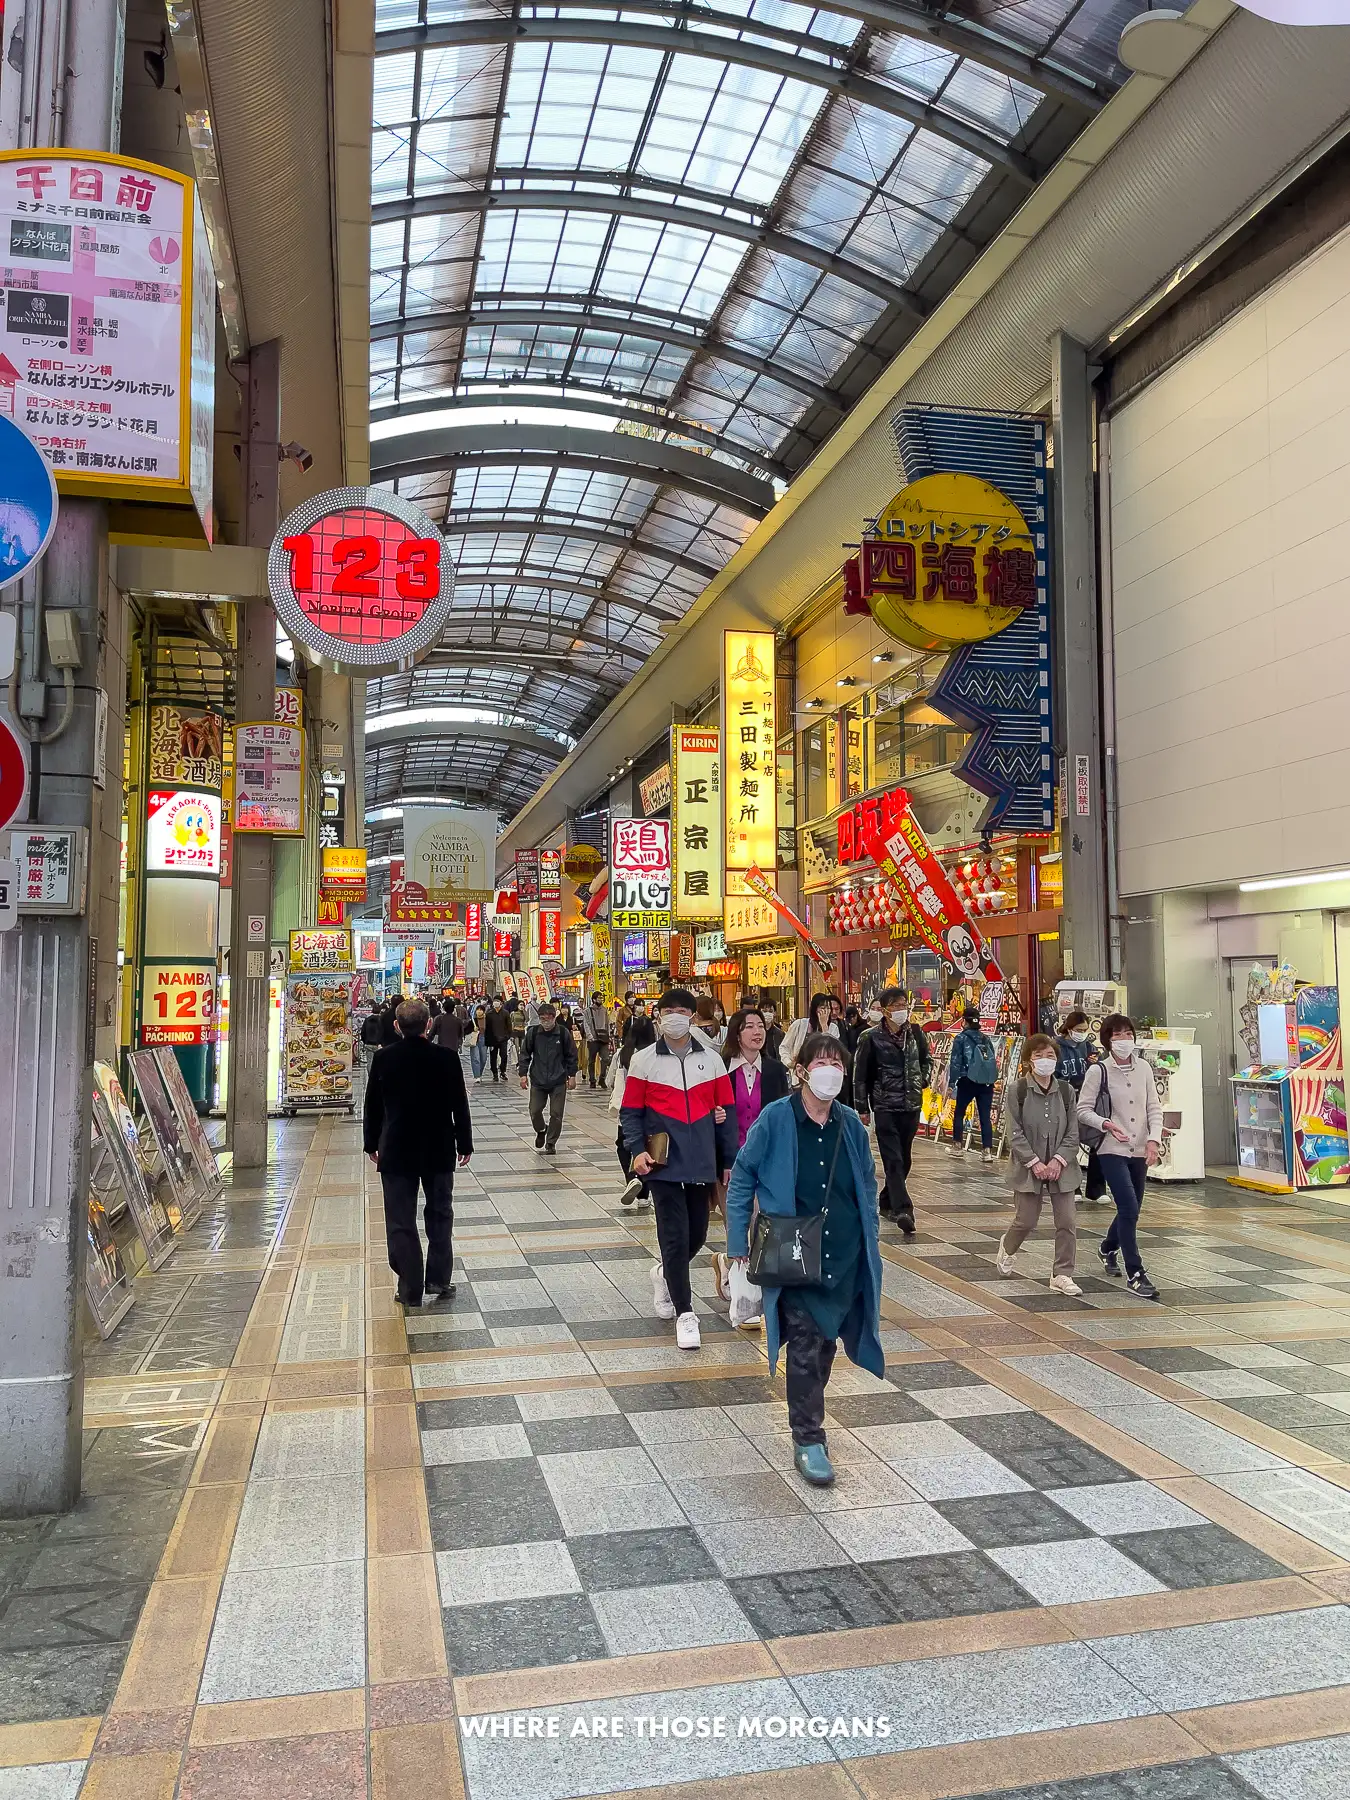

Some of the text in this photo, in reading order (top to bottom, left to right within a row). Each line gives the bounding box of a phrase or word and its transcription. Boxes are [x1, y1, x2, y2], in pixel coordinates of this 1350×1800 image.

[16, 166, 157, 212] 千日前
[16, 200, 152, 225] ミナミ千日前商店会
[26, 230, 56, 240] なんば
[12, 238, 69, 253] グランド花月
[159, 266, 169, 274] 北
[135, 281, 160, 293] 地下鉄
[22, 338, 58, 348] ローソン
[27, 358, 112, 376] 左側ローソン横
[27, 371, 175, 397] なんばオリエンタルホテル
[26, 409, 158, 434] なんばグランド花月
[33, 435, 87, 449] つ角右折
[862, 518, 1036, 544] スロットシアター
[283, 533, 441, 599] 123
[246, 726, 292, 739] 千日前
[762, 691, 774, 777] つけ麺専門店
[153, 708, 180, 781] 北海道
[683, 737, 717, 749] KIRIN
[738, 701, 759, 824] 三田製麺所
[183, 758, 221, 789] 酒場
[1078, 758, 1089, 814] 看板取付禁止
[150, 794, 167, 806] 4F
[683, 778, 710, 897] 正宗屋
[165, 847, 213, 860] ジャンカラ
[430, 842, 470, 851] NAMBA
[421, 853, 478, 863] ORIENTAL
[27, 836, 44, 899] 閉厳禁
[430, 865, 470, 874] HOTEL
[541, 870, 559, 878] DVD
[468, 903, 479, 936] カラオケ
[491, 916, 521, 925] MARUHA
[613, 912, 670, 928] 千日前店
[294, 933, 348, 951] 北海道
[304, 951, 338, 968] 酒場
[158, 972, 212, 986] NAMBA
[153, 988, 214, 1018] 123
[145, 1031, 195, 1043] PACHINKO
